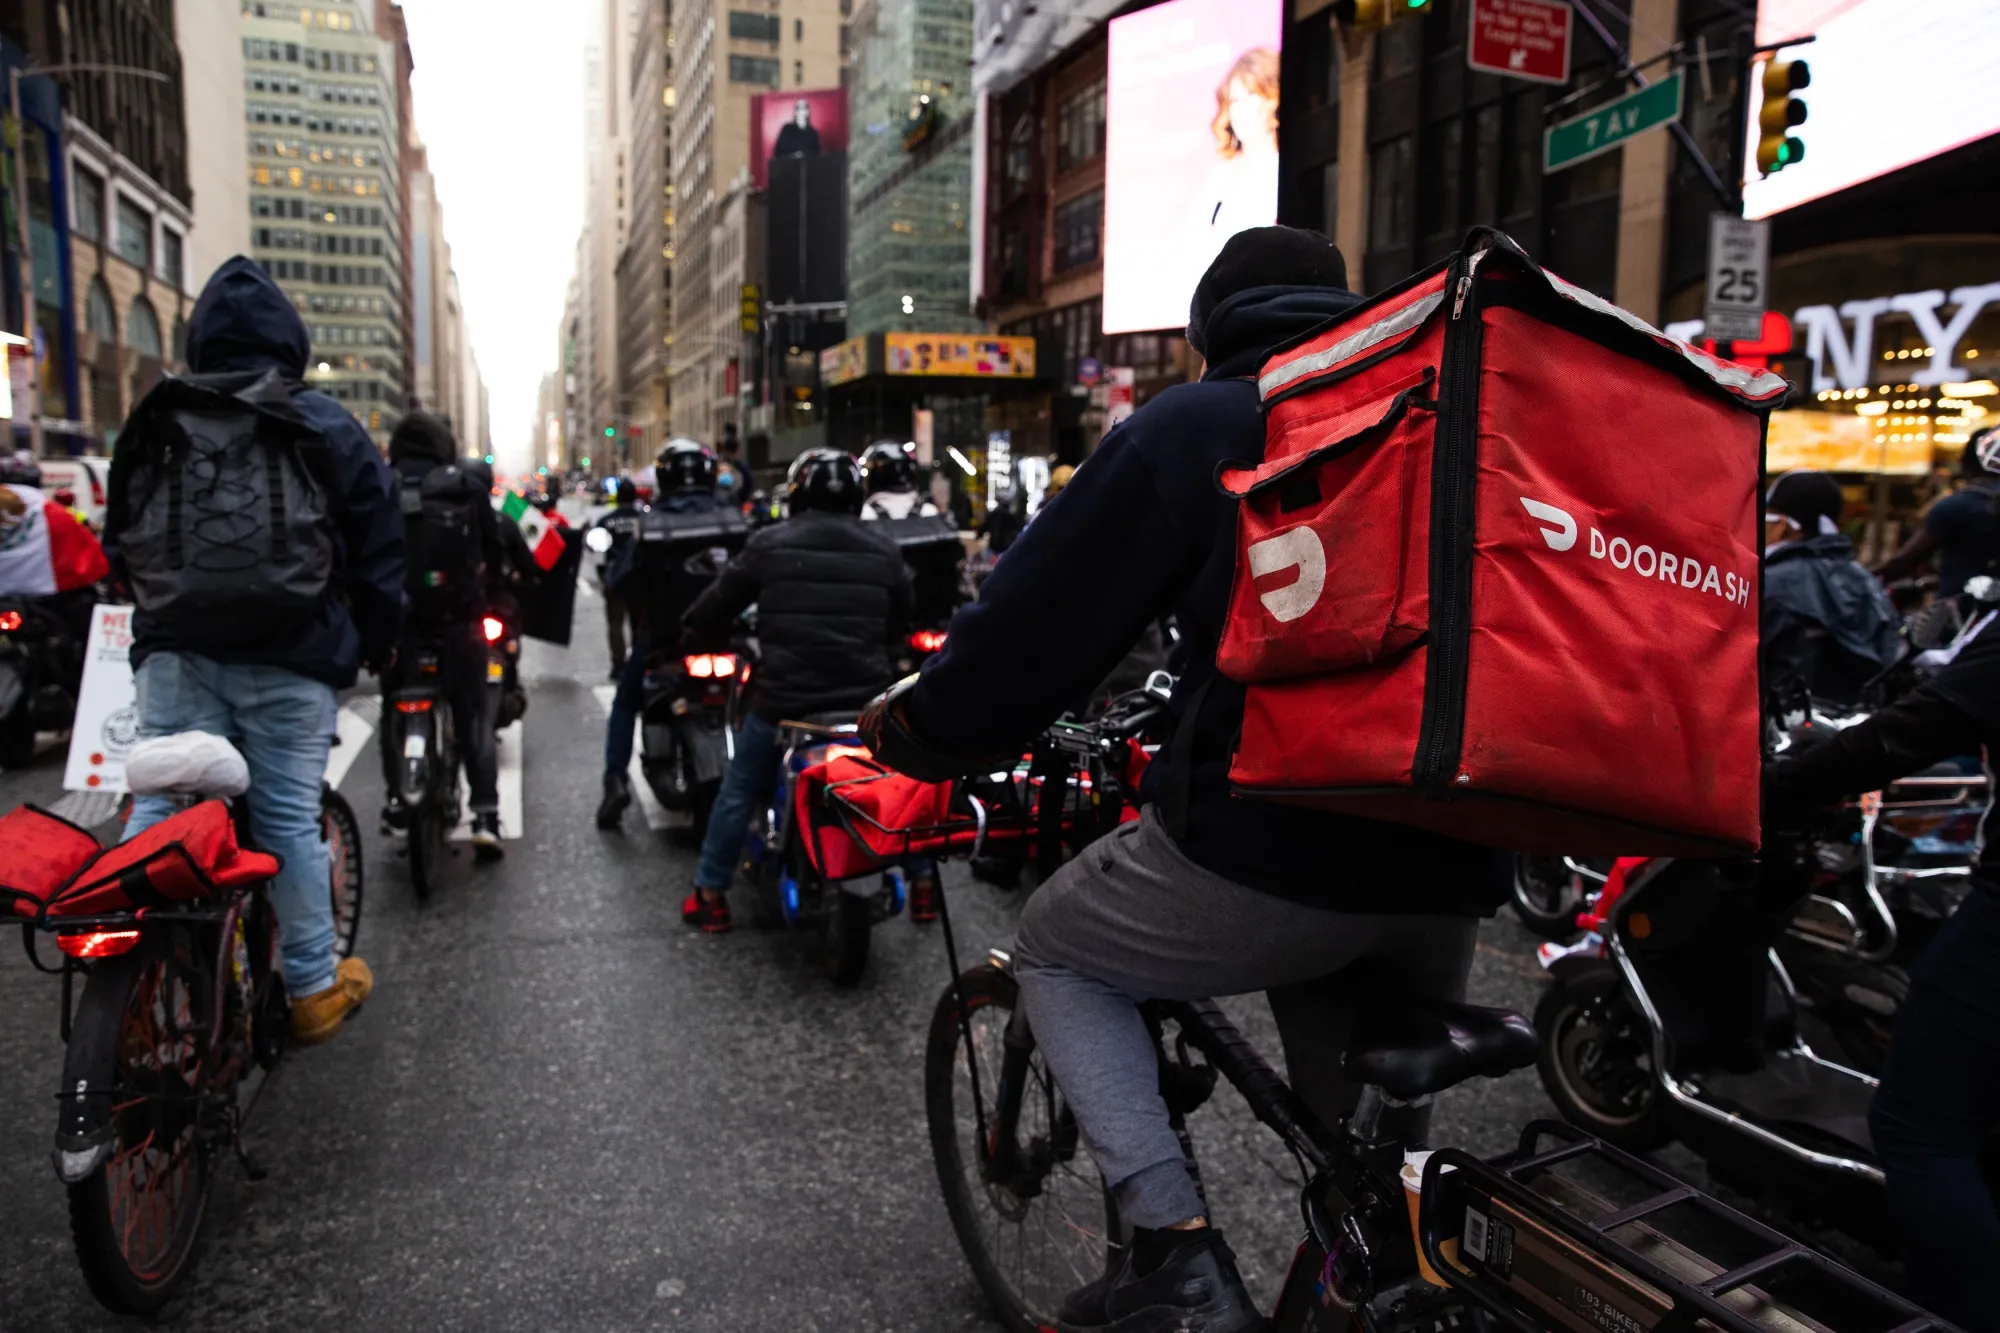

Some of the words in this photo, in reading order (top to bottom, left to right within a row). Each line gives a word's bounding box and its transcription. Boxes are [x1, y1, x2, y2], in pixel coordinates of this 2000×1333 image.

[1585, 118, 1599, 147] 7
[1716, 267, 1759, 303] 25
[1795, 281, 2000, 393] NY
[1590, 527, 1750, 609] DOORDASH
[1580, 1289, 1600, 1308] 103
[1603, 1303, 1641, 1333] BIKES
